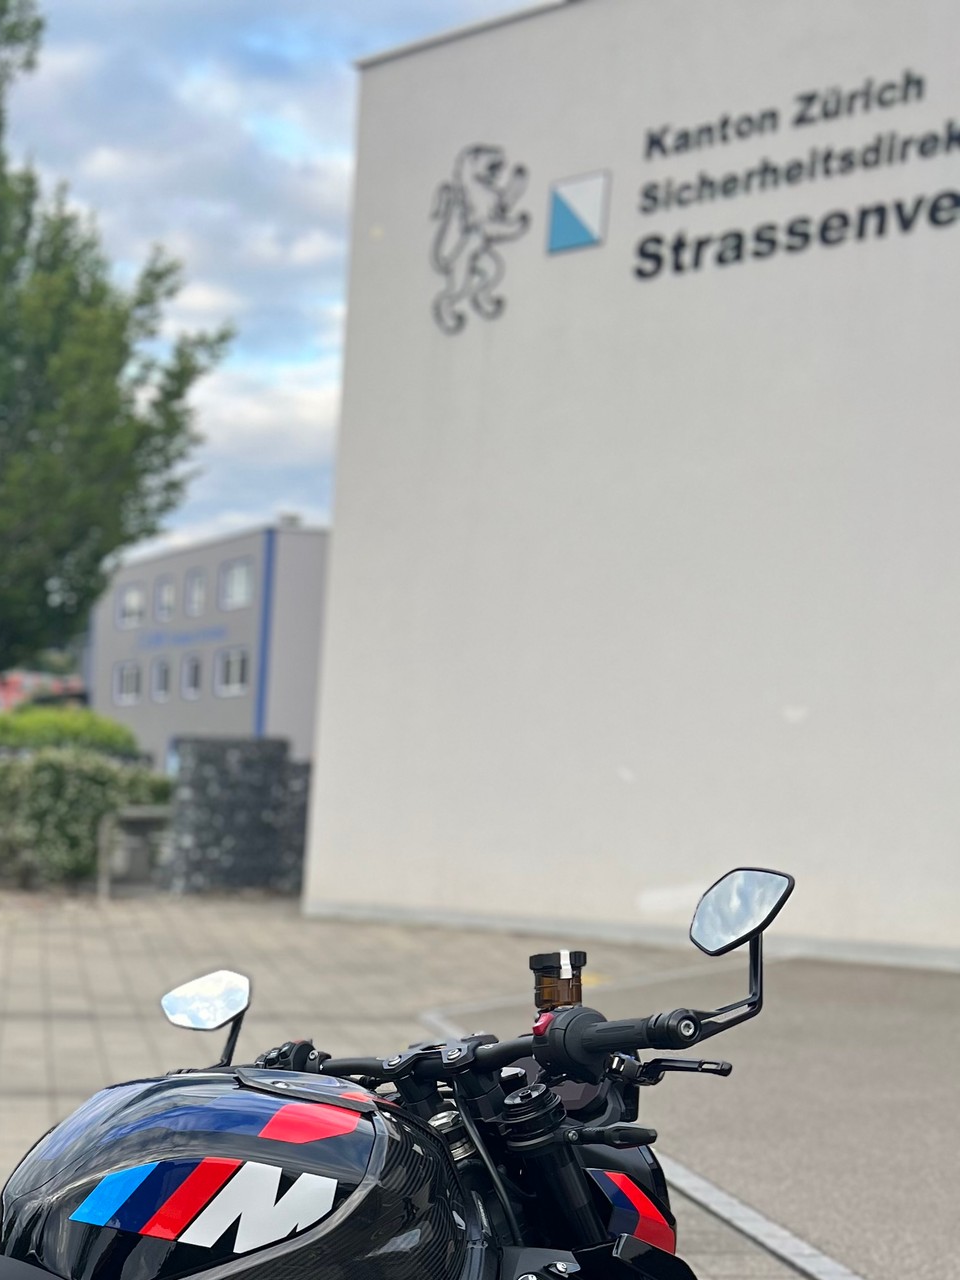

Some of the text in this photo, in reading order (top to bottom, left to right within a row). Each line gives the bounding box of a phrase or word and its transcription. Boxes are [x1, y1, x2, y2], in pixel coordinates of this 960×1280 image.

[644, 68, 925, 160] Kanton Zürich
[634, 188, 960, 281] Strassenve
